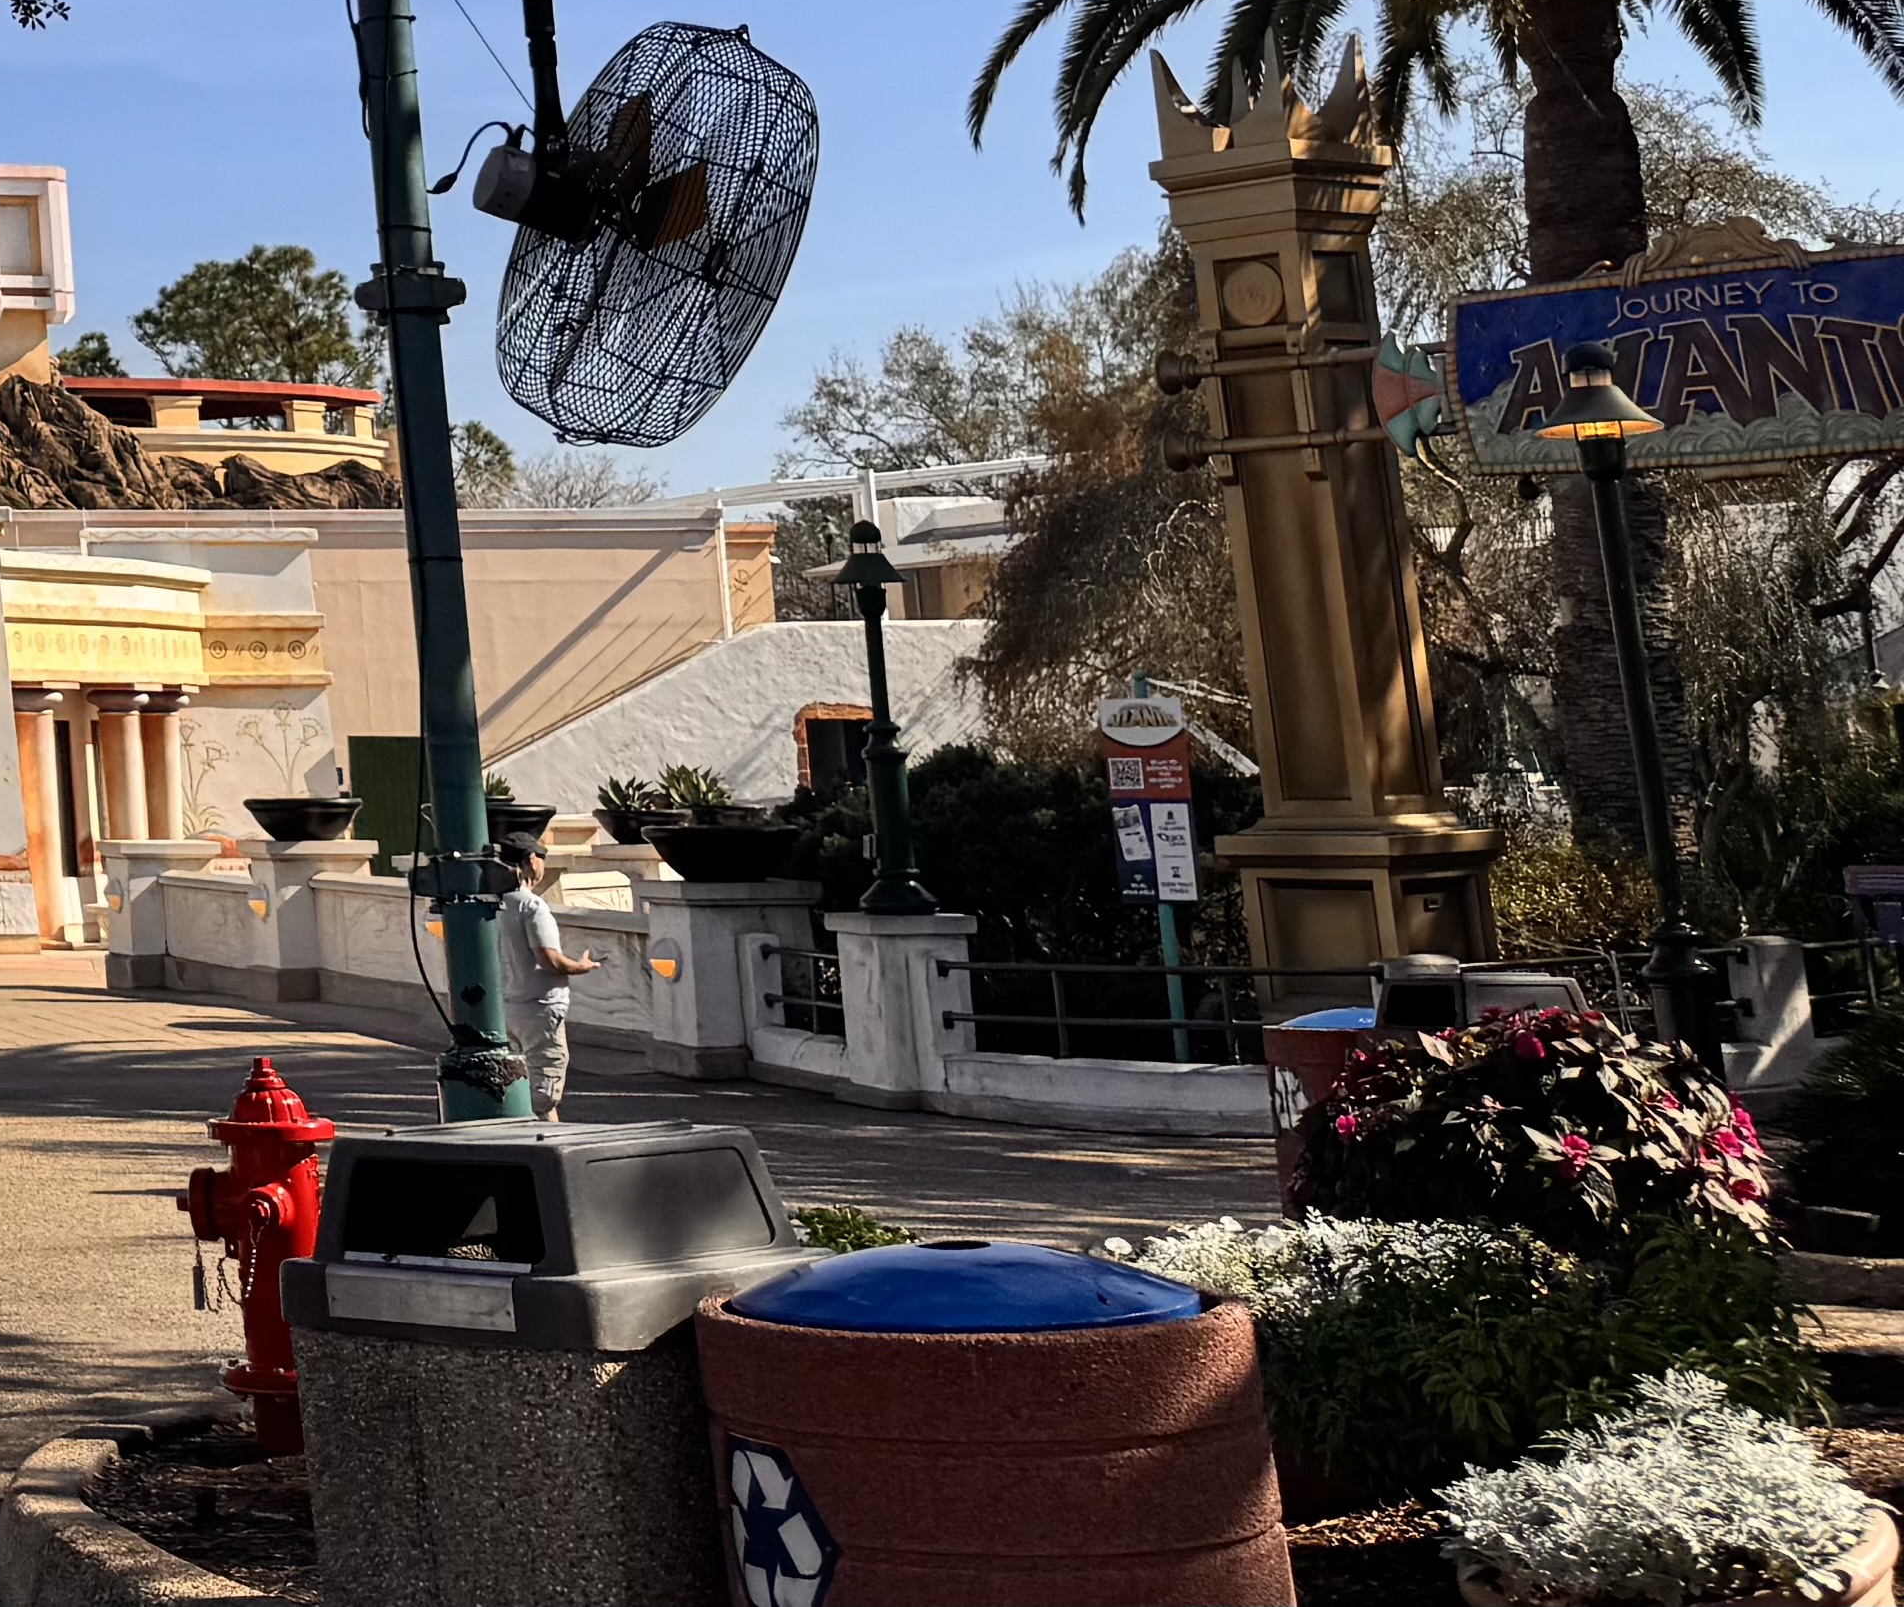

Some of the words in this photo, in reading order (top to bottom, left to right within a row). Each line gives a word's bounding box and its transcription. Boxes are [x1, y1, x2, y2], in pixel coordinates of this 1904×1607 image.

[1607, 279, 1776, 328] JOURNEY
[1790, 280, 1838, 305] TO
[1497, 312, 1904, 435] ALANT
